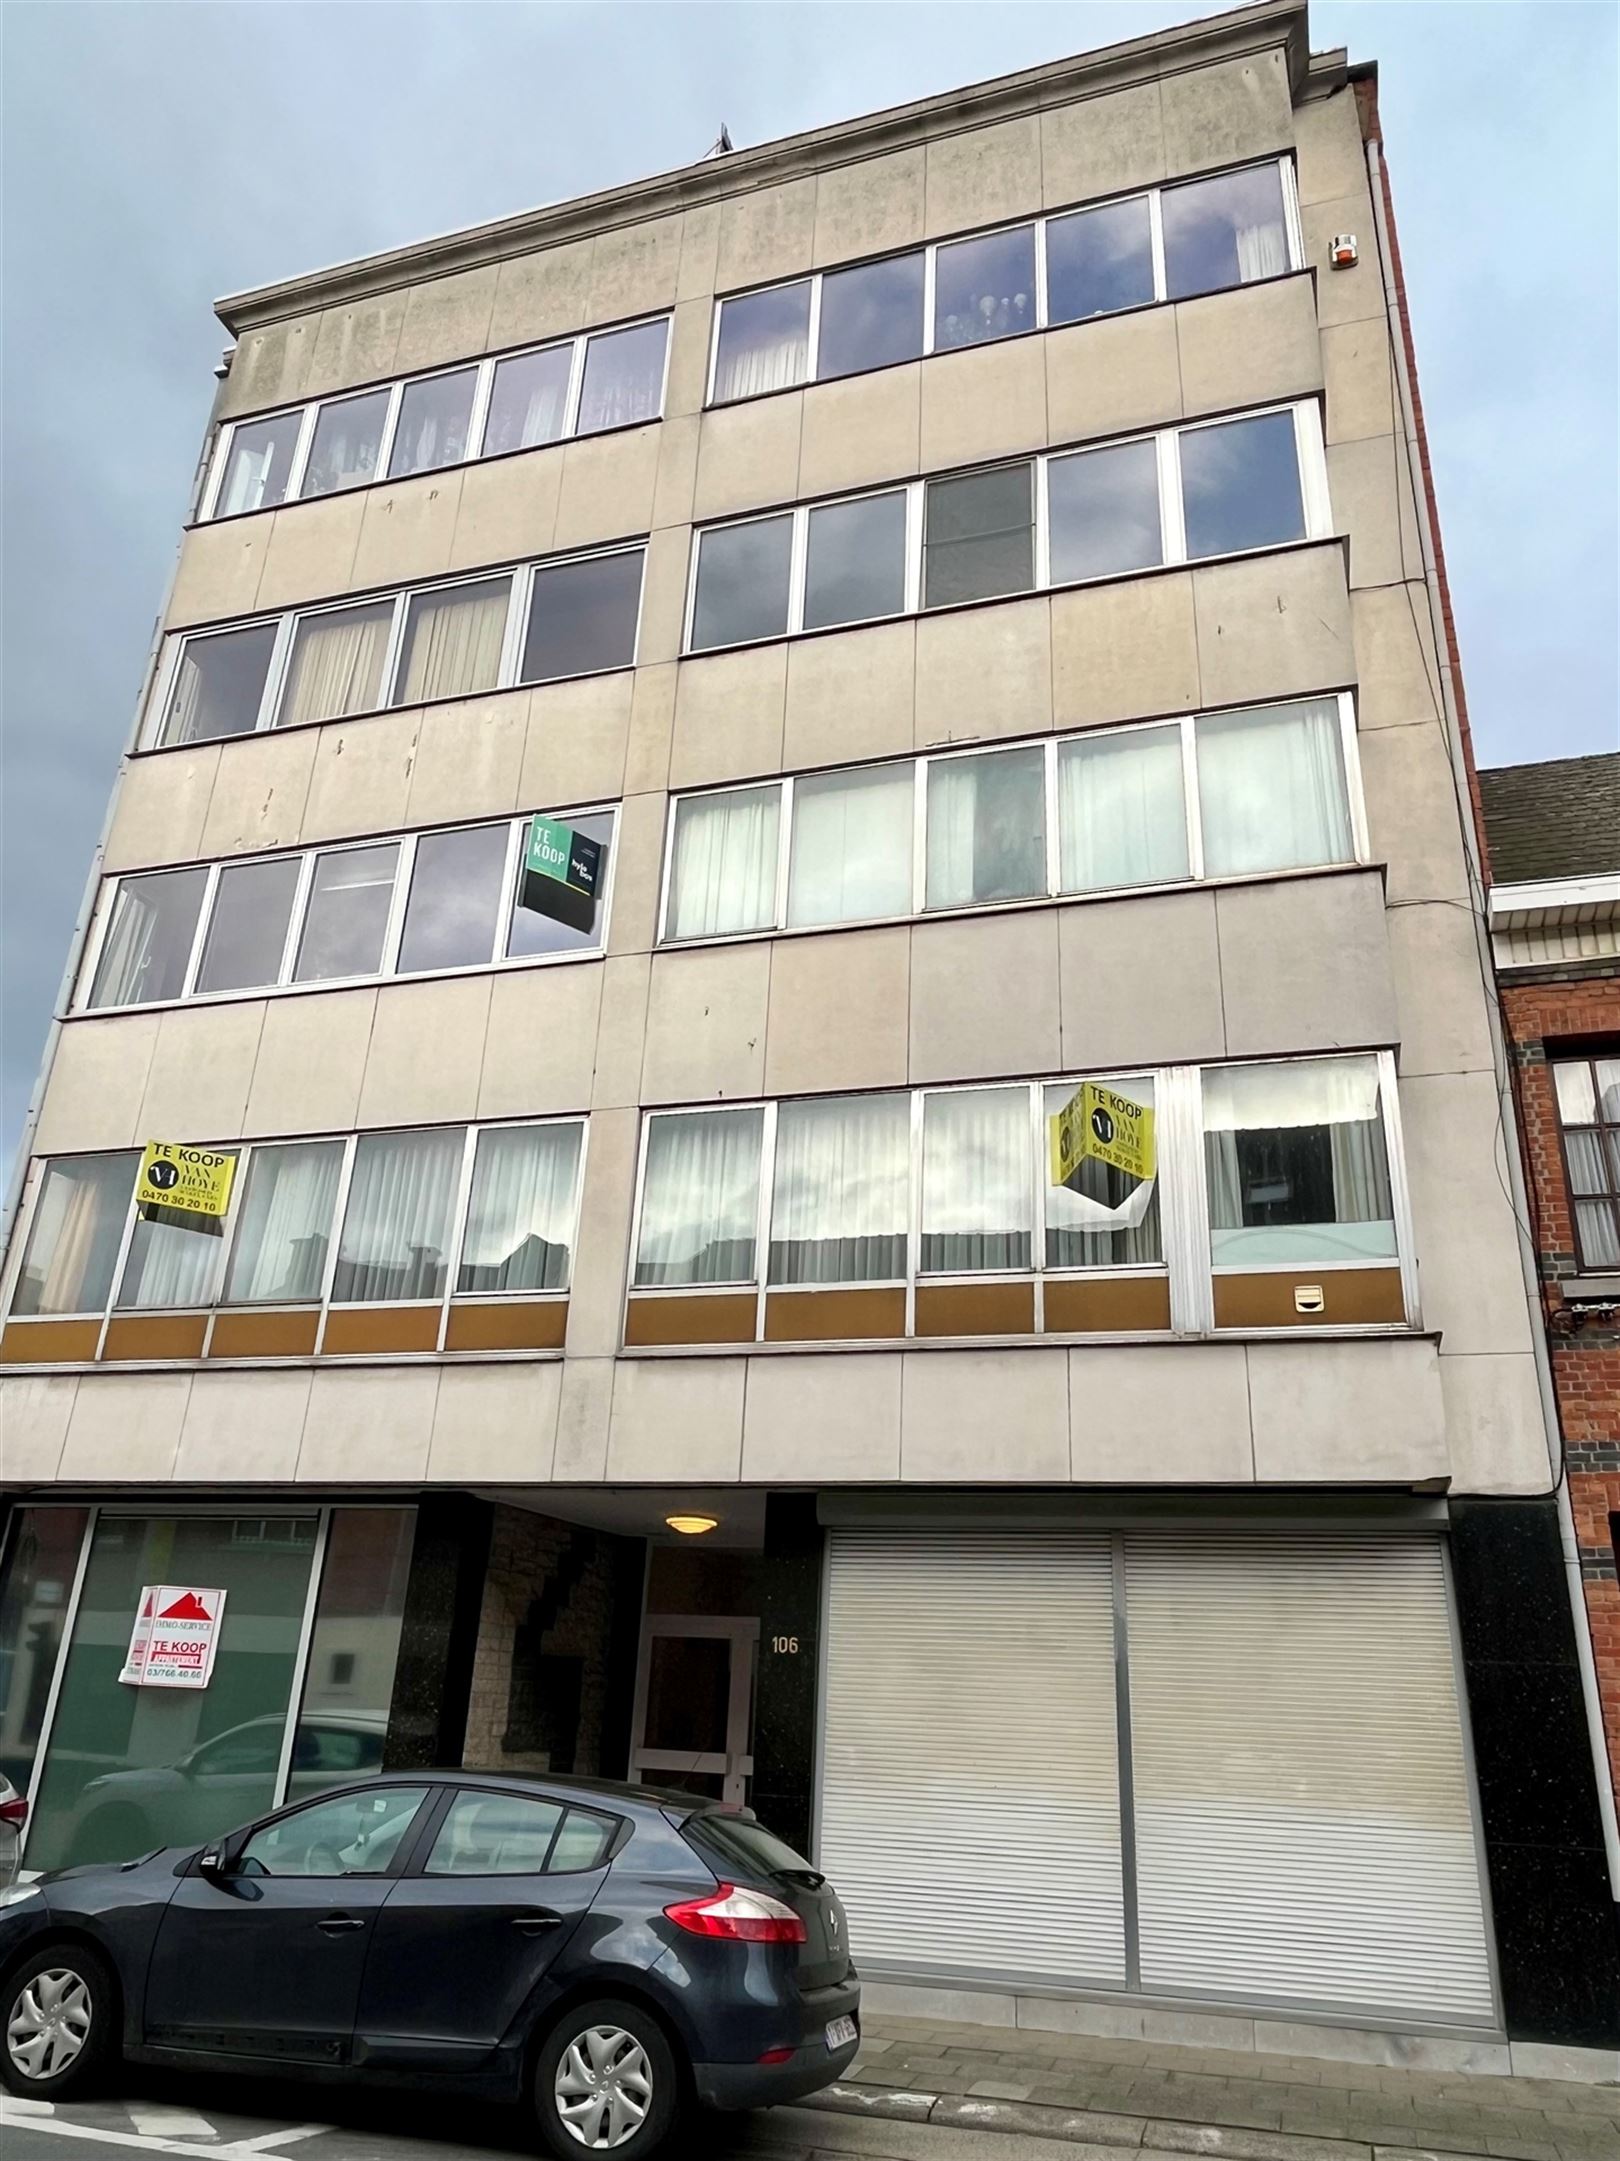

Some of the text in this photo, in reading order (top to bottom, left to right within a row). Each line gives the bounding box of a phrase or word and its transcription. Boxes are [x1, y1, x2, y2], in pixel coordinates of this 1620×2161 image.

[537, 827, 551, 844] TE
[534, 843, 565, 865] KOOP
[1090, 1086, 1106, 1105] TE
[1109, 1094, 1142, 1121] KOOP
[153, 1142, 225, 1168] TE KOOP
[1092, 1143, 1112, 1159] 0470
[1123, 1157, 1133, 1169] 20
[142, 1189, 169, 1203] 0470
[171, 1195, 185, 1206] 30
[186, 1198, 201, 1209] 20
[203, 1202, 216, 1212] 10
[153, 1640, 169, 1651] TE
[171, 1641, 207, 1654] KOOP
[771, 1636, 799, 1654] 106
